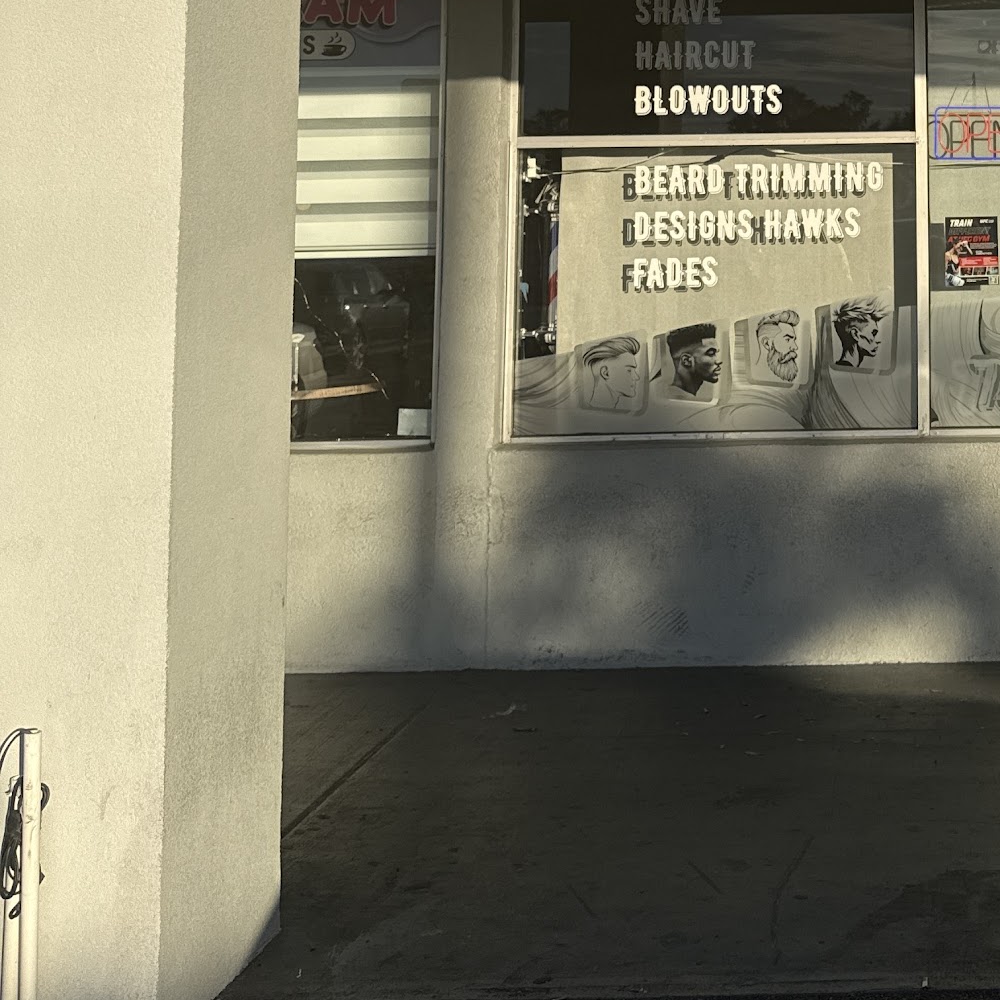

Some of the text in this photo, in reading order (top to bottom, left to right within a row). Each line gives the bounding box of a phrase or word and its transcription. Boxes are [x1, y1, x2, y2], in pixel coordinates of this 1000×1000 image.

[635, 40, 756, 70] HAIRCUT
[634, 84, 783, 116] BLOWOUTS
[634, 161, 884, 195] BEARD TRIMMING
[633, 206, 862, 241] DESIGNS HAWKS
[949, 219, 973, 227] TRAIN
[632, 256, 719, 289] FADES
